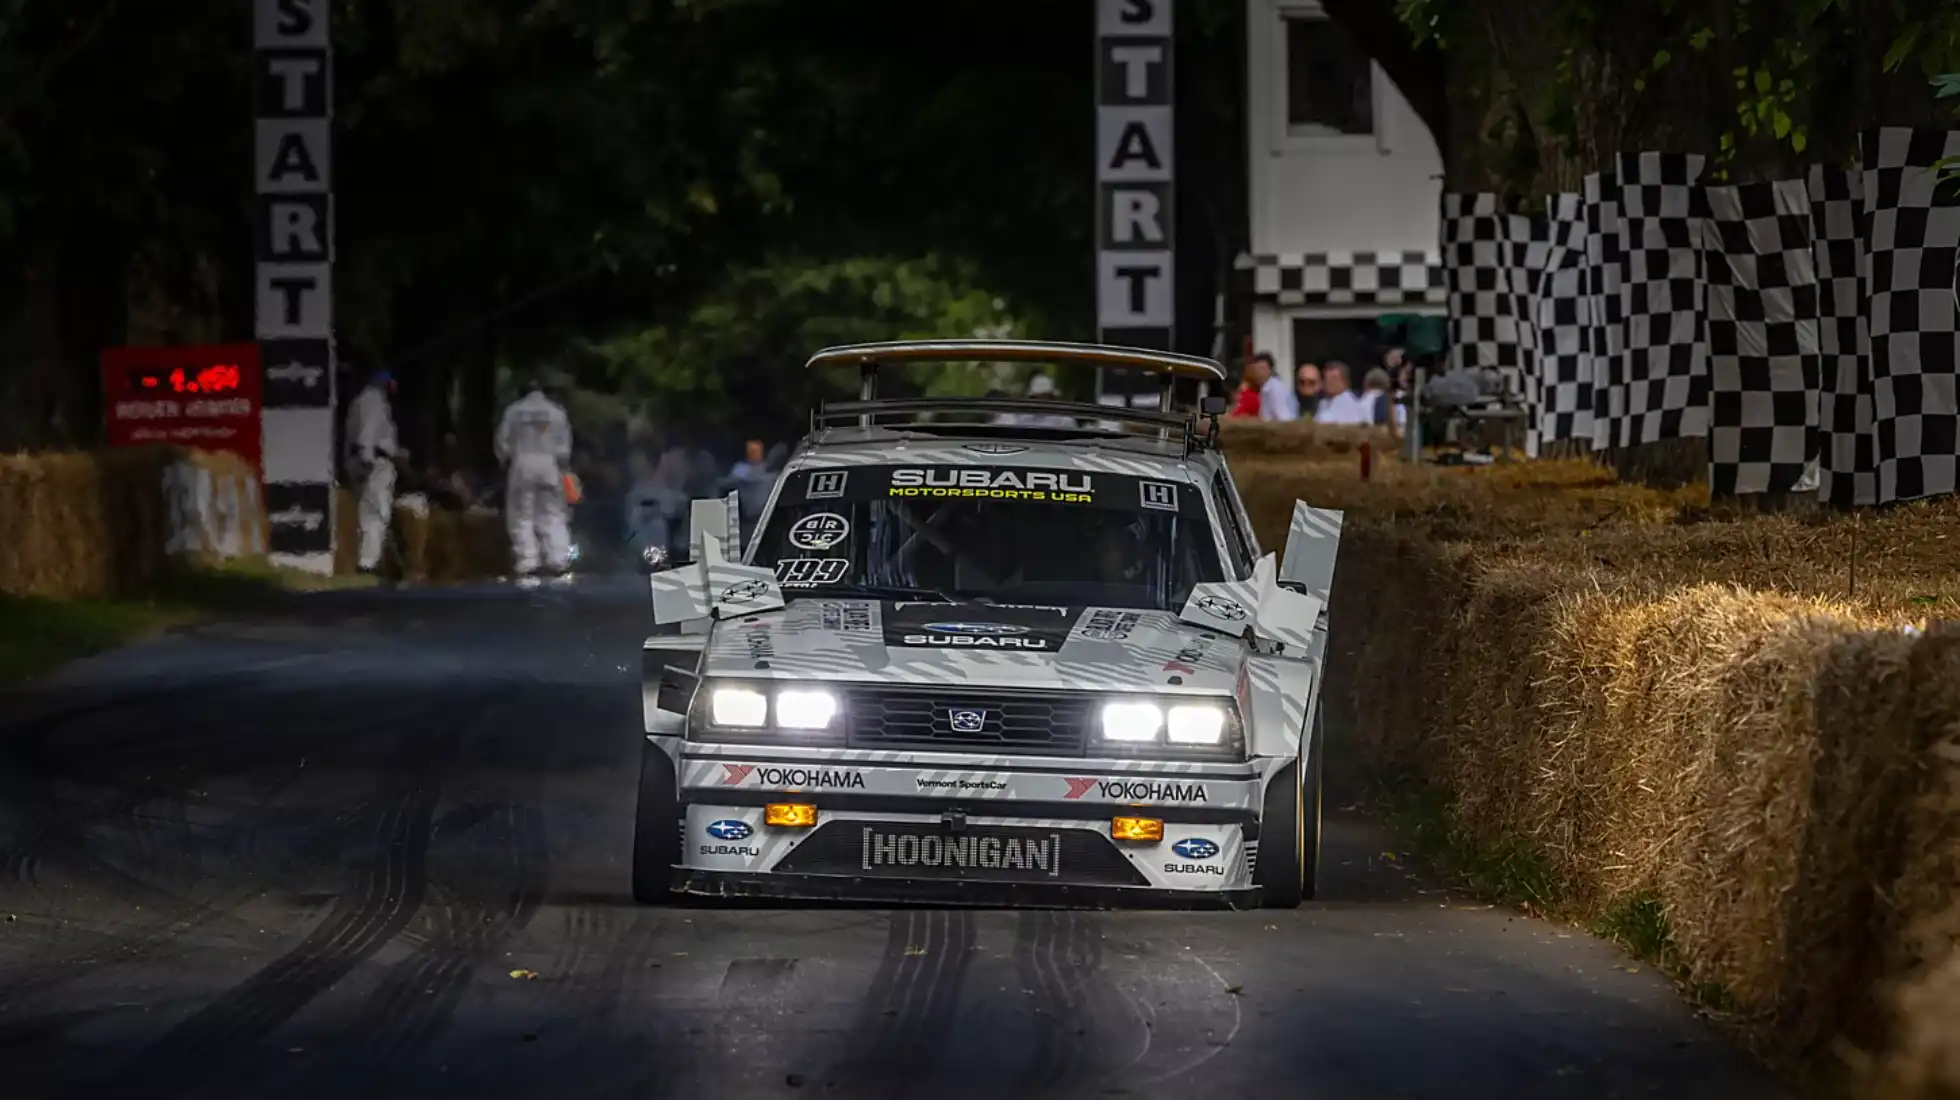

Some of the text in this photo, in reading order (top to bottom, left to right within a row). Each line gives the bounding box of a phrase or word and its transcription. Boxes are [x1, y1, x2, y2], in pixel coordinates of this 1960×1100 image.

[268, 0, 322, 326] START
[891, 469, 1091, 493] SUBARU
[888, 487, 1092, 504] MOTORSPORTS USA
[775, 558, 849, 584] 199
[903, 634, 1045, 648] SUBARU
[756, 767, 865, 789] YOKOHAMA
[917, 779, 1007, 790] Vermont SportsCar
[1098, 782, 1208, 803] YOKOHAMA
[700, 845, 759, 857] SUBARU
[1164, 863, 1224, 876] SUBARU
